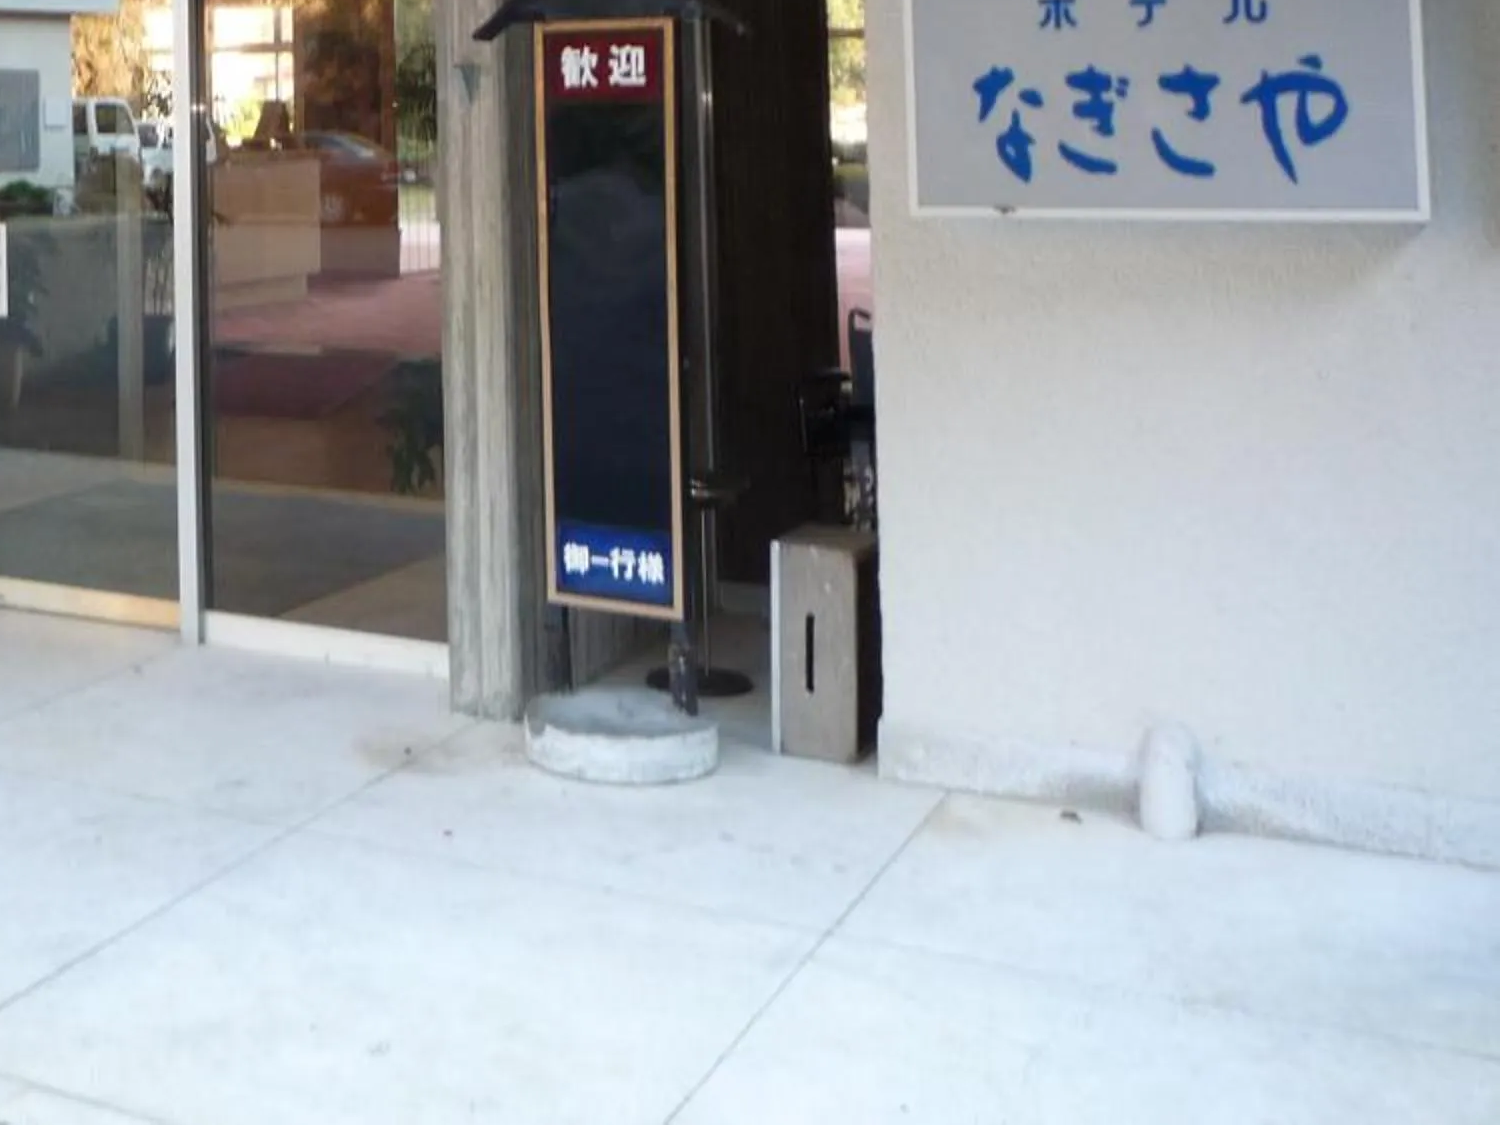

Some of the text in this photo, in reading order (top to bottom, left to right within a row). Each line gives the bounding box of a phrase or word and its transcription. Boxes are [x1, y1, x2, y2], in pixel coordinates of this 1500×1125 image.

[560, 43, 647, 90] 歓迎
[972, 53, 1349, 185] なぎさや
